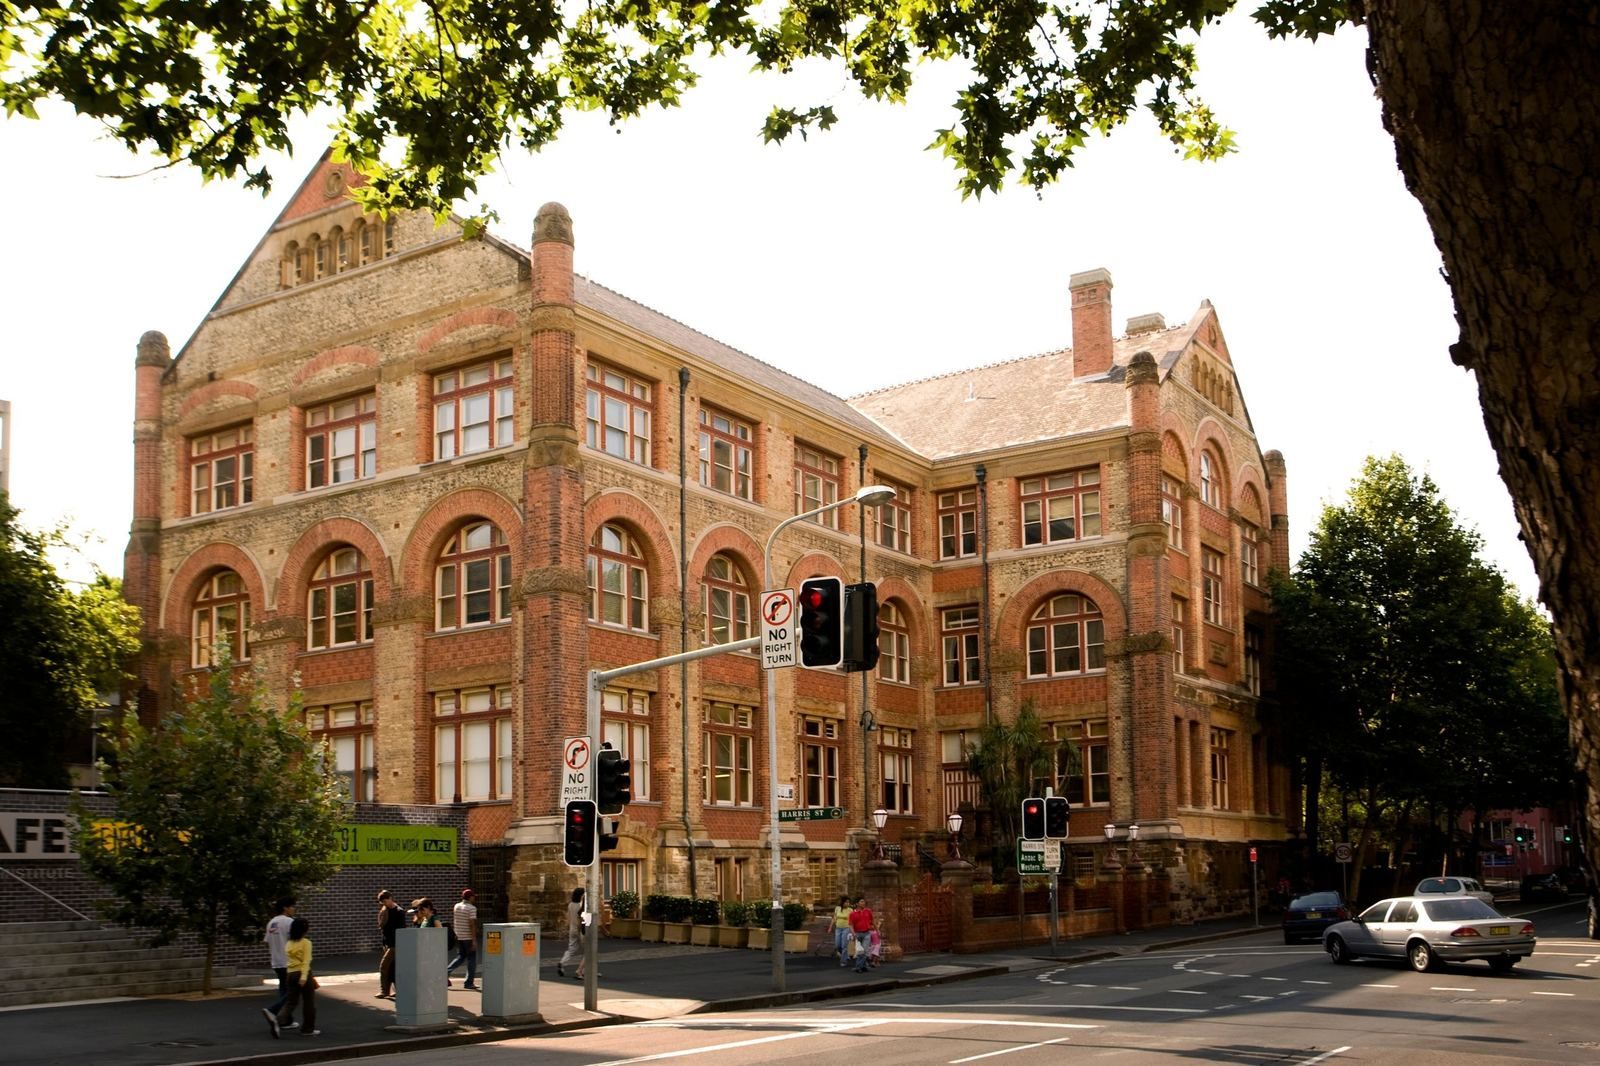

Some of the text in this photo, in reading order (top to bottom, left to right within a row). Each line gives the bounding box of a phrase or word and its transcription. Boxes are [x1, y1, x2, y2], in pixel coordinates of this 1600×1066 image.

[769, 628, 787, 641] NO
[765, 643, 792, 653] RIGHT
[767, 654, 792, 664] TURN
[568, 773, 585, 784] NO
[564, 786, 588, 795] RIGHT
[367, 838, 419, 852] LOVE YOUR WORK
[424, 841, 448, 851] TAFE
